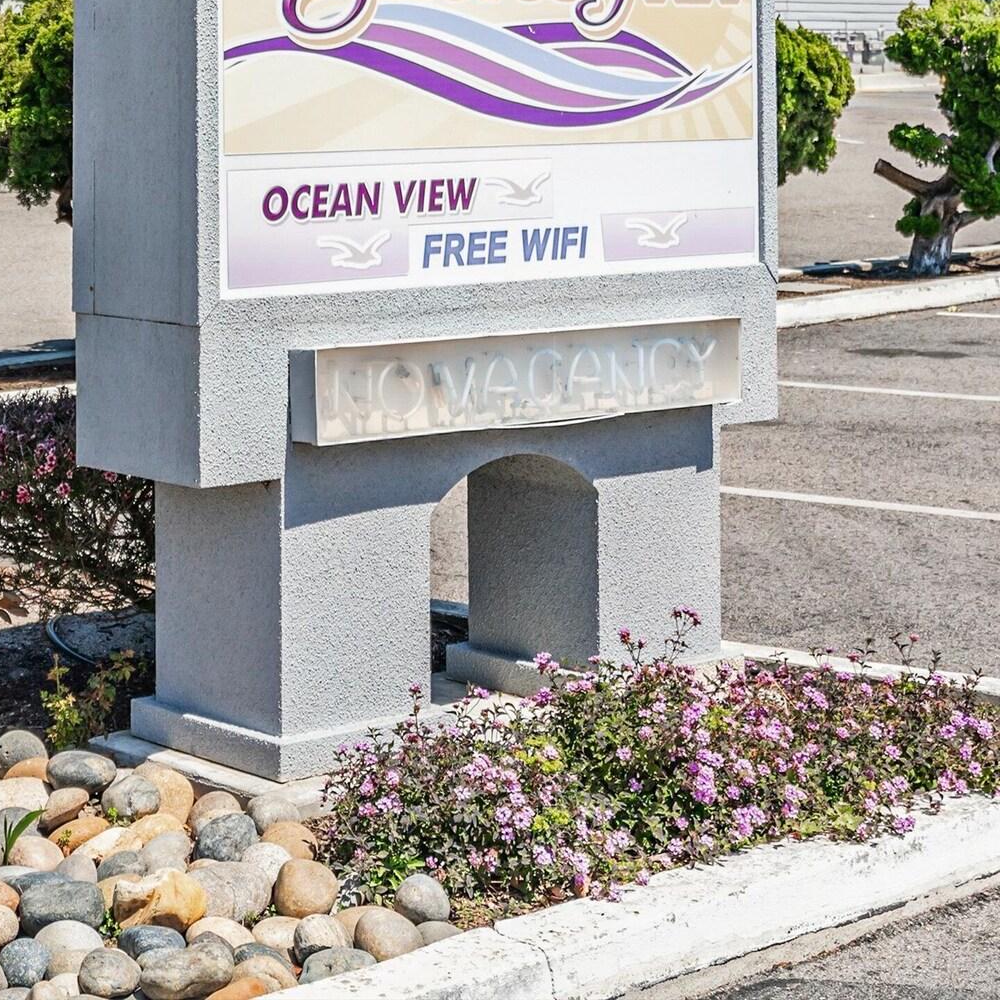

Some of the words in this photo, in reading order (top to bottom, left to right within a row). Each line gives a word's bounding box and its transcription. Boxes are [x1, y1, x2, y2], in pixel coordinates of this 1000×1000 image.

[261, 180, 382, 221] OCEAN
[393, 177, 477, 214] VIEW
[422, 231, 508, 269] FREE
[521, 226, 589, 262] WIFI
[332, 361, 424, 421] NO
[436, 338, 717, 417] VACANCY
